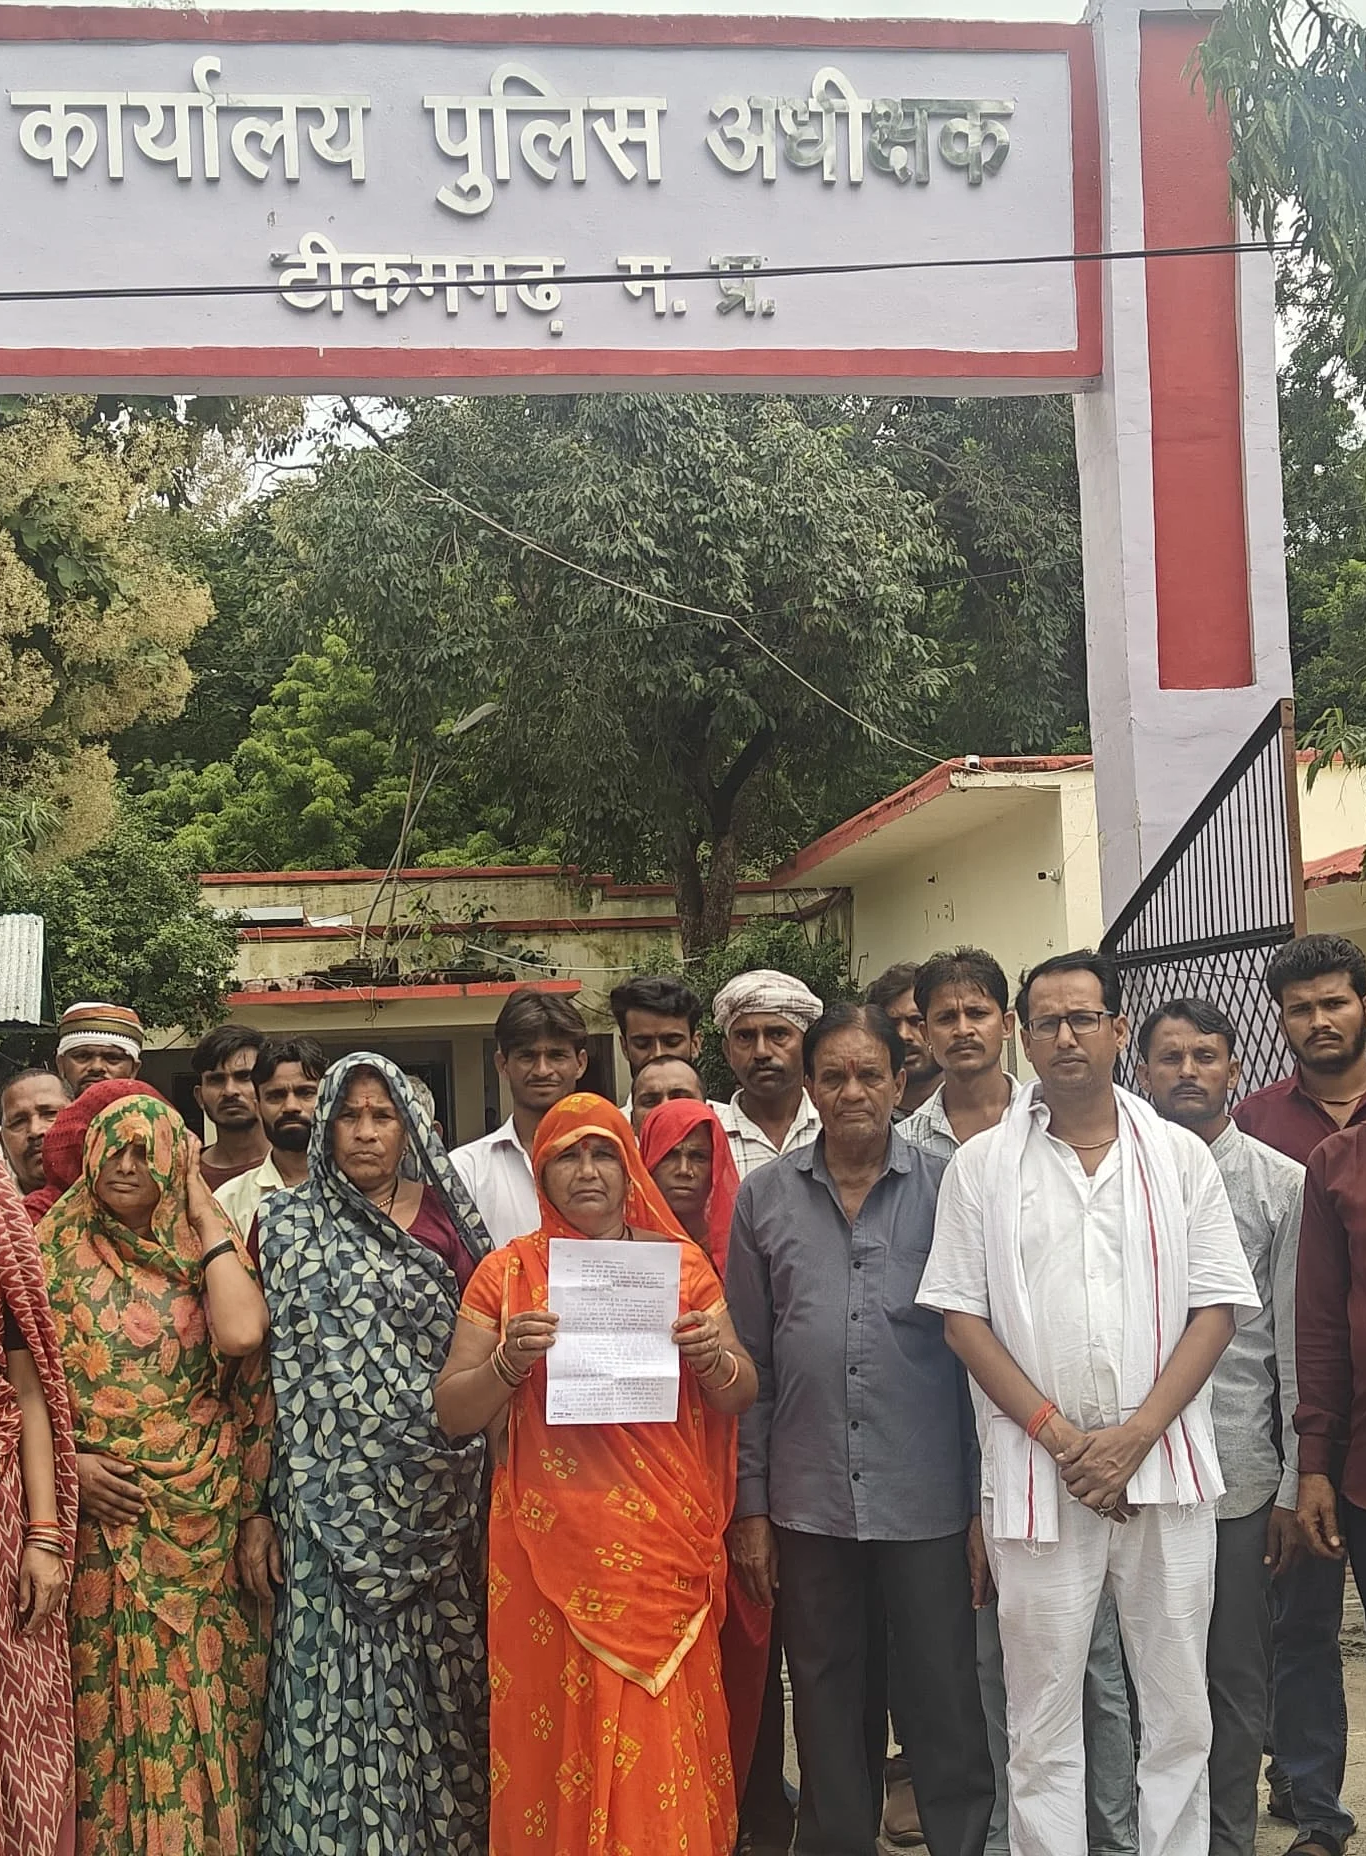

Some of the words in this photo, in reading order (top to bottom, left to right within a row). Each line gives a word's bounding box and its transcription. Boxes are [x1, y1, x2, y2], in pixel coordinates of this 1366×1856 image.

[10, 56, 371, 183] कार्यालय
[423, 62, 668, 215] पुलिस
[705, 66, 1016, 184] अधीक्षक
[269, 231, 567, 336] टीकमगढ़
